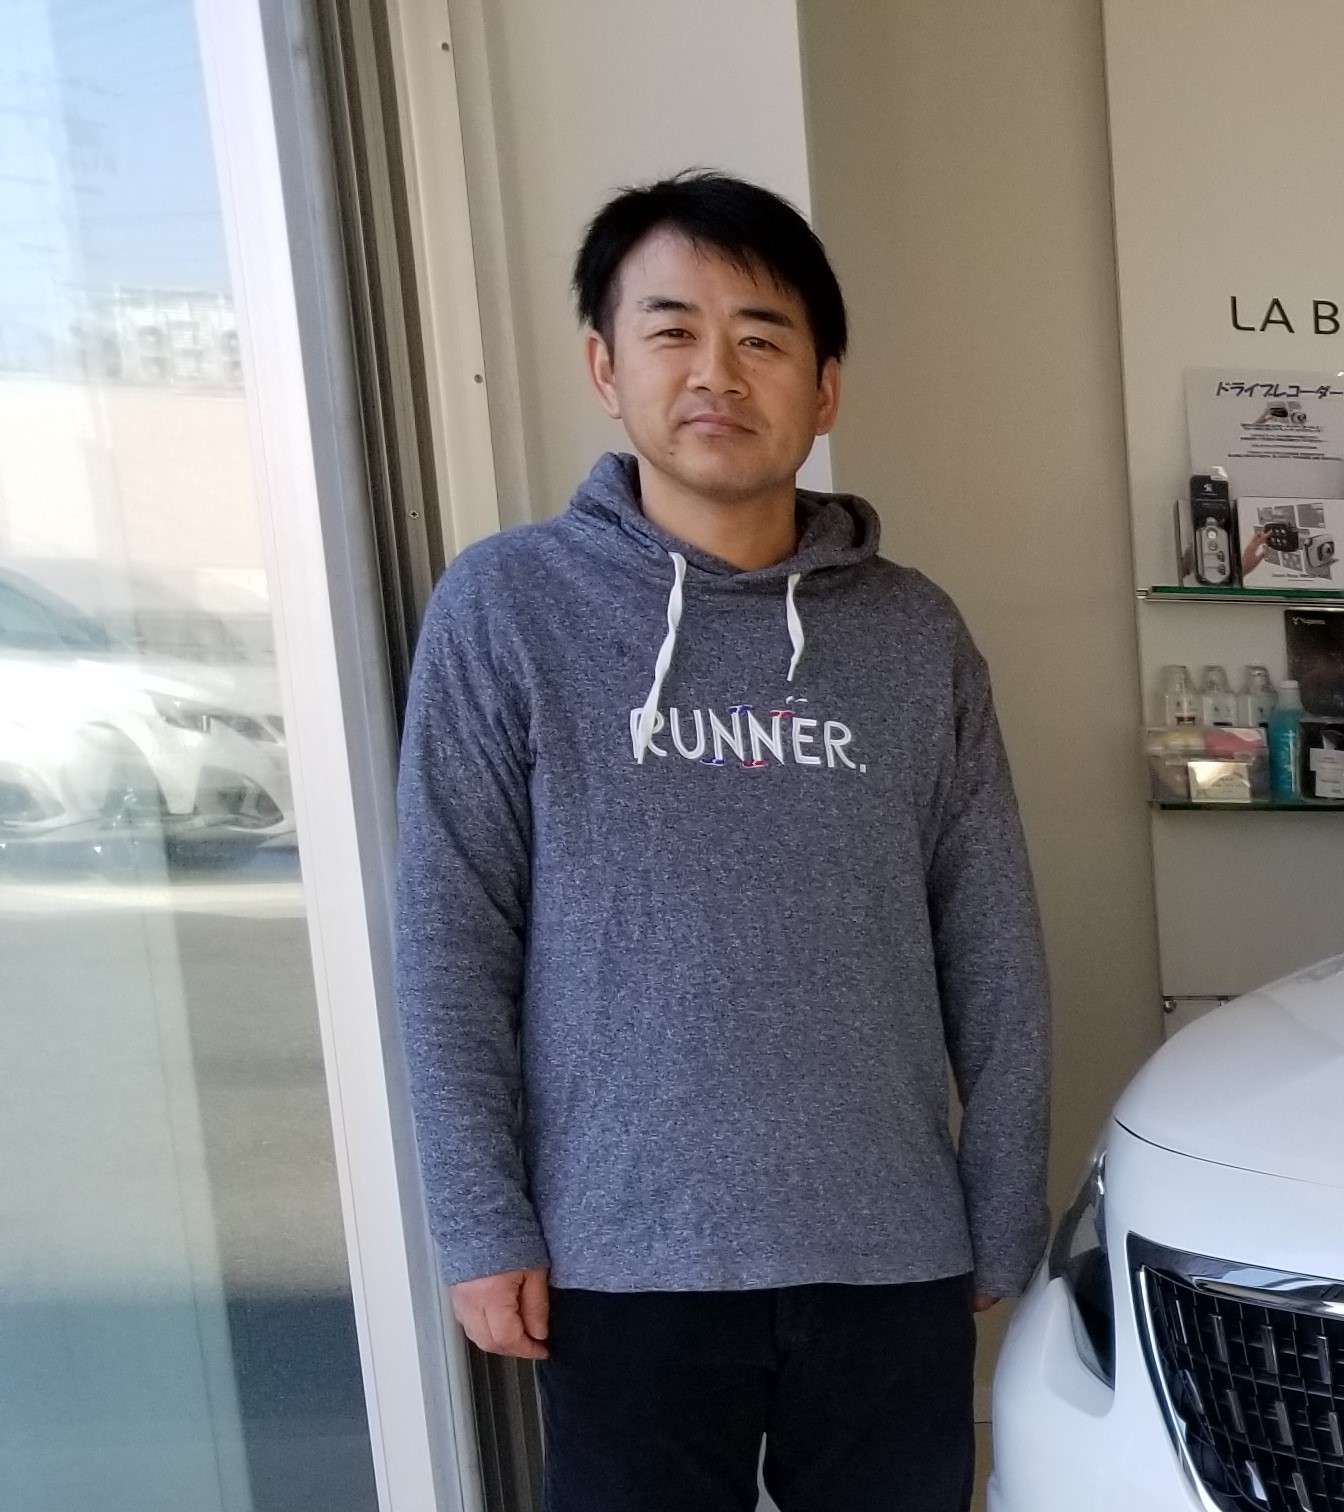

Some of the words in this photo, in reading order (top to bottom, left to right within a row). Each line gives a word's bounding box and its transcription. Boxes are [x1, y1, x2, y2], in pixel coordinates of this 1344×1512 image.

[1230, 295, 1295, 333] LA
[1215, 376, 1344, 400] ドライブレコーダー
